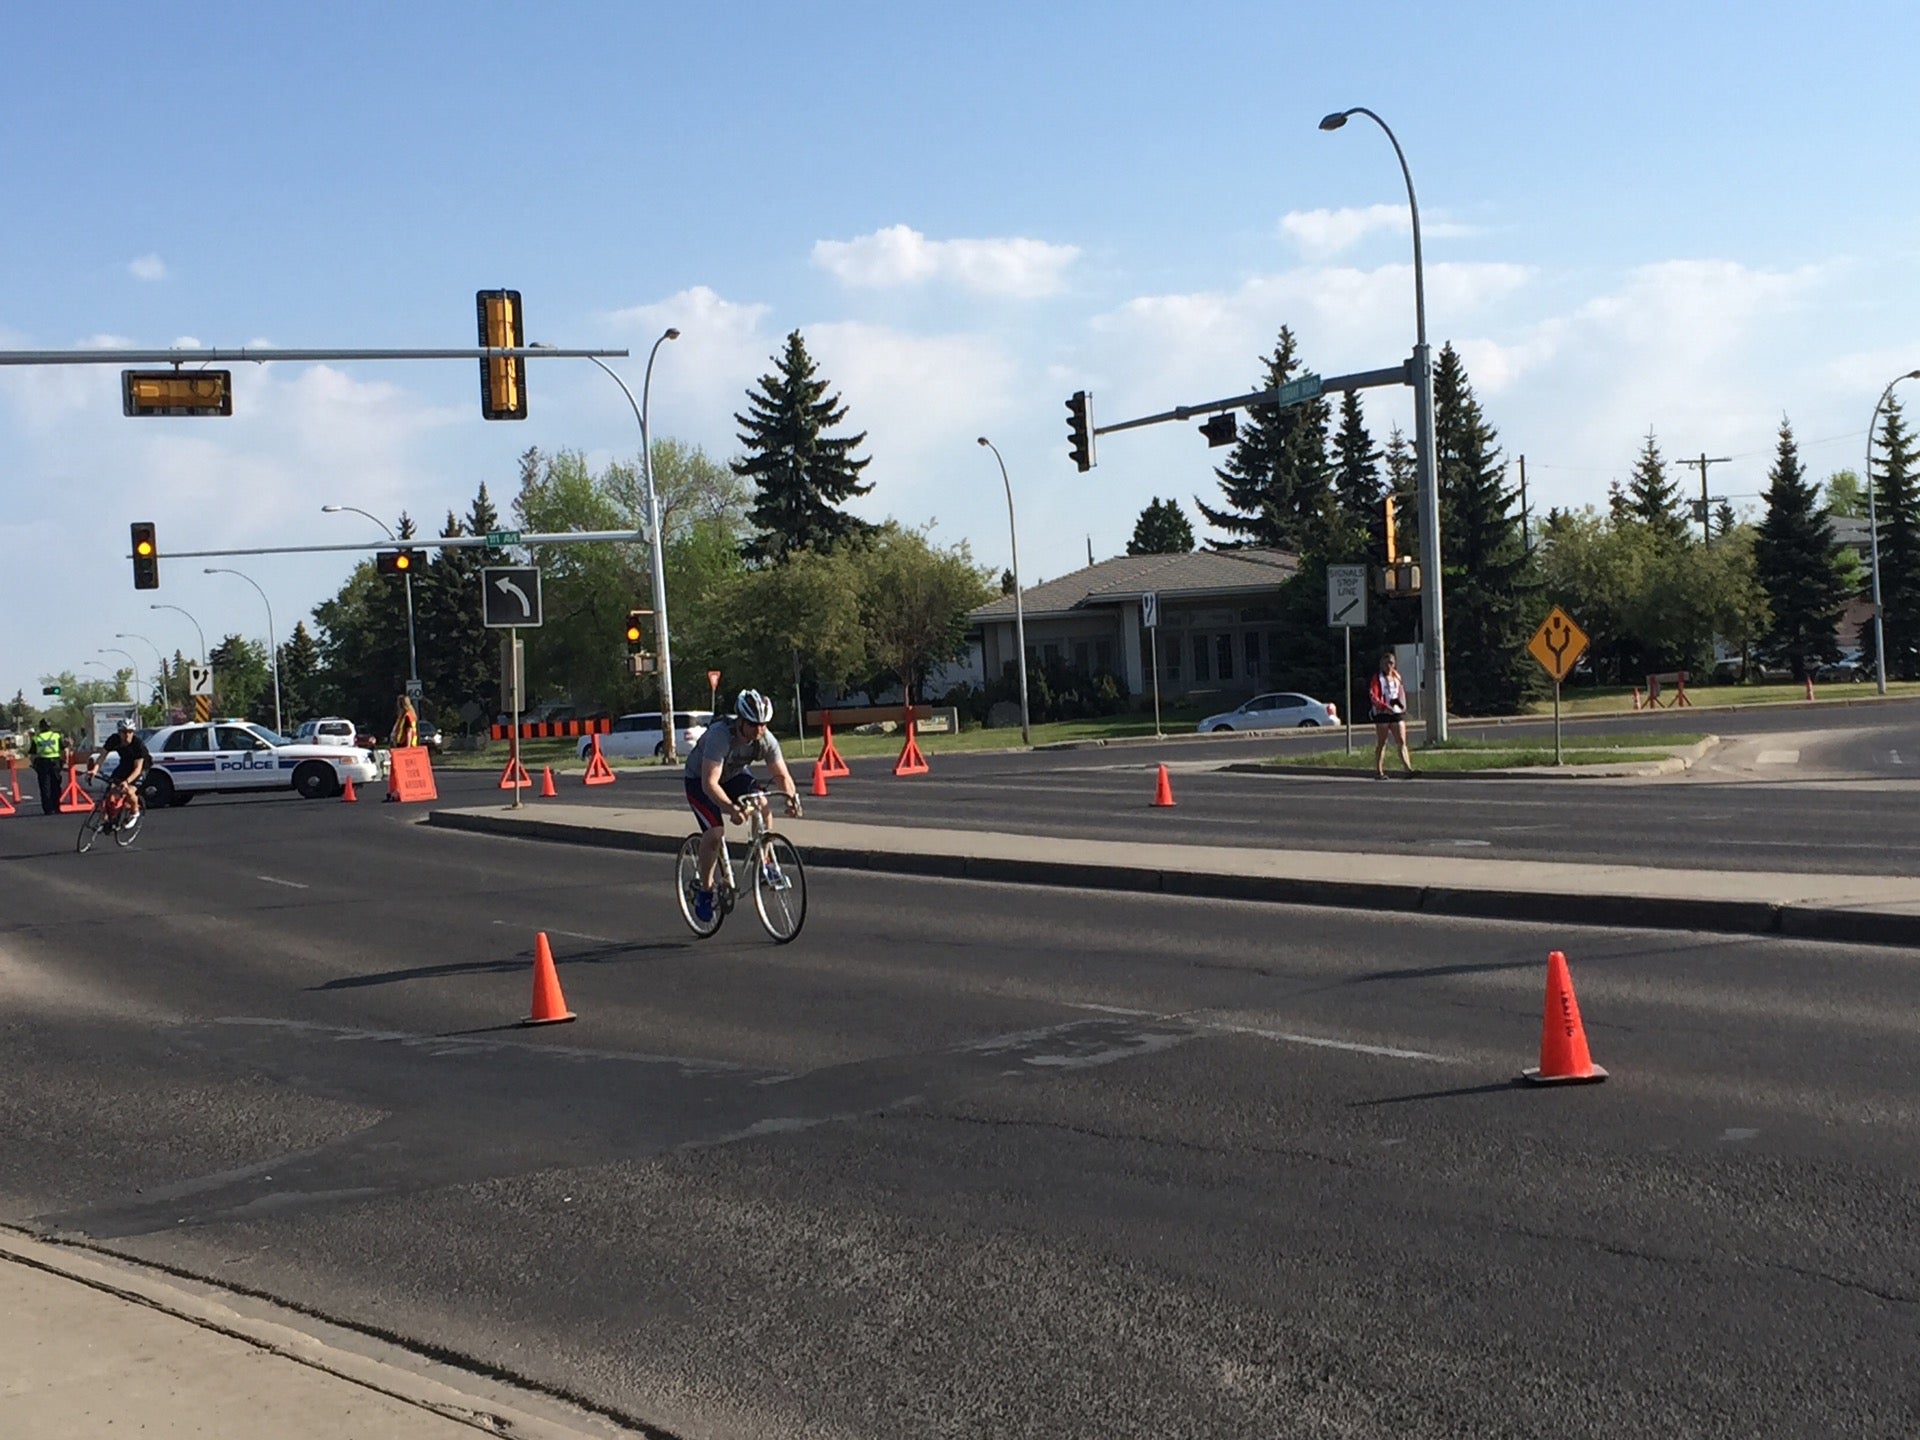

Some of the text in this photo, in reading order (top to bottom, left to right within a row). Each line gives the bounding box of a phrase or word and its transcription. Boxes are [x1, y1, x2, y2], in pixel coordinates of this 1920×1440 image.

[503, 533, 519, 543] AVE
[1329, 568, 1365, 578] SIGNALS
[1336, 578, 1359, 587] STOP
[1337, 588, 1357, 596] LINE
[408, 688, 421, 698] 60
[221, 760, 273, 770] POLICE
